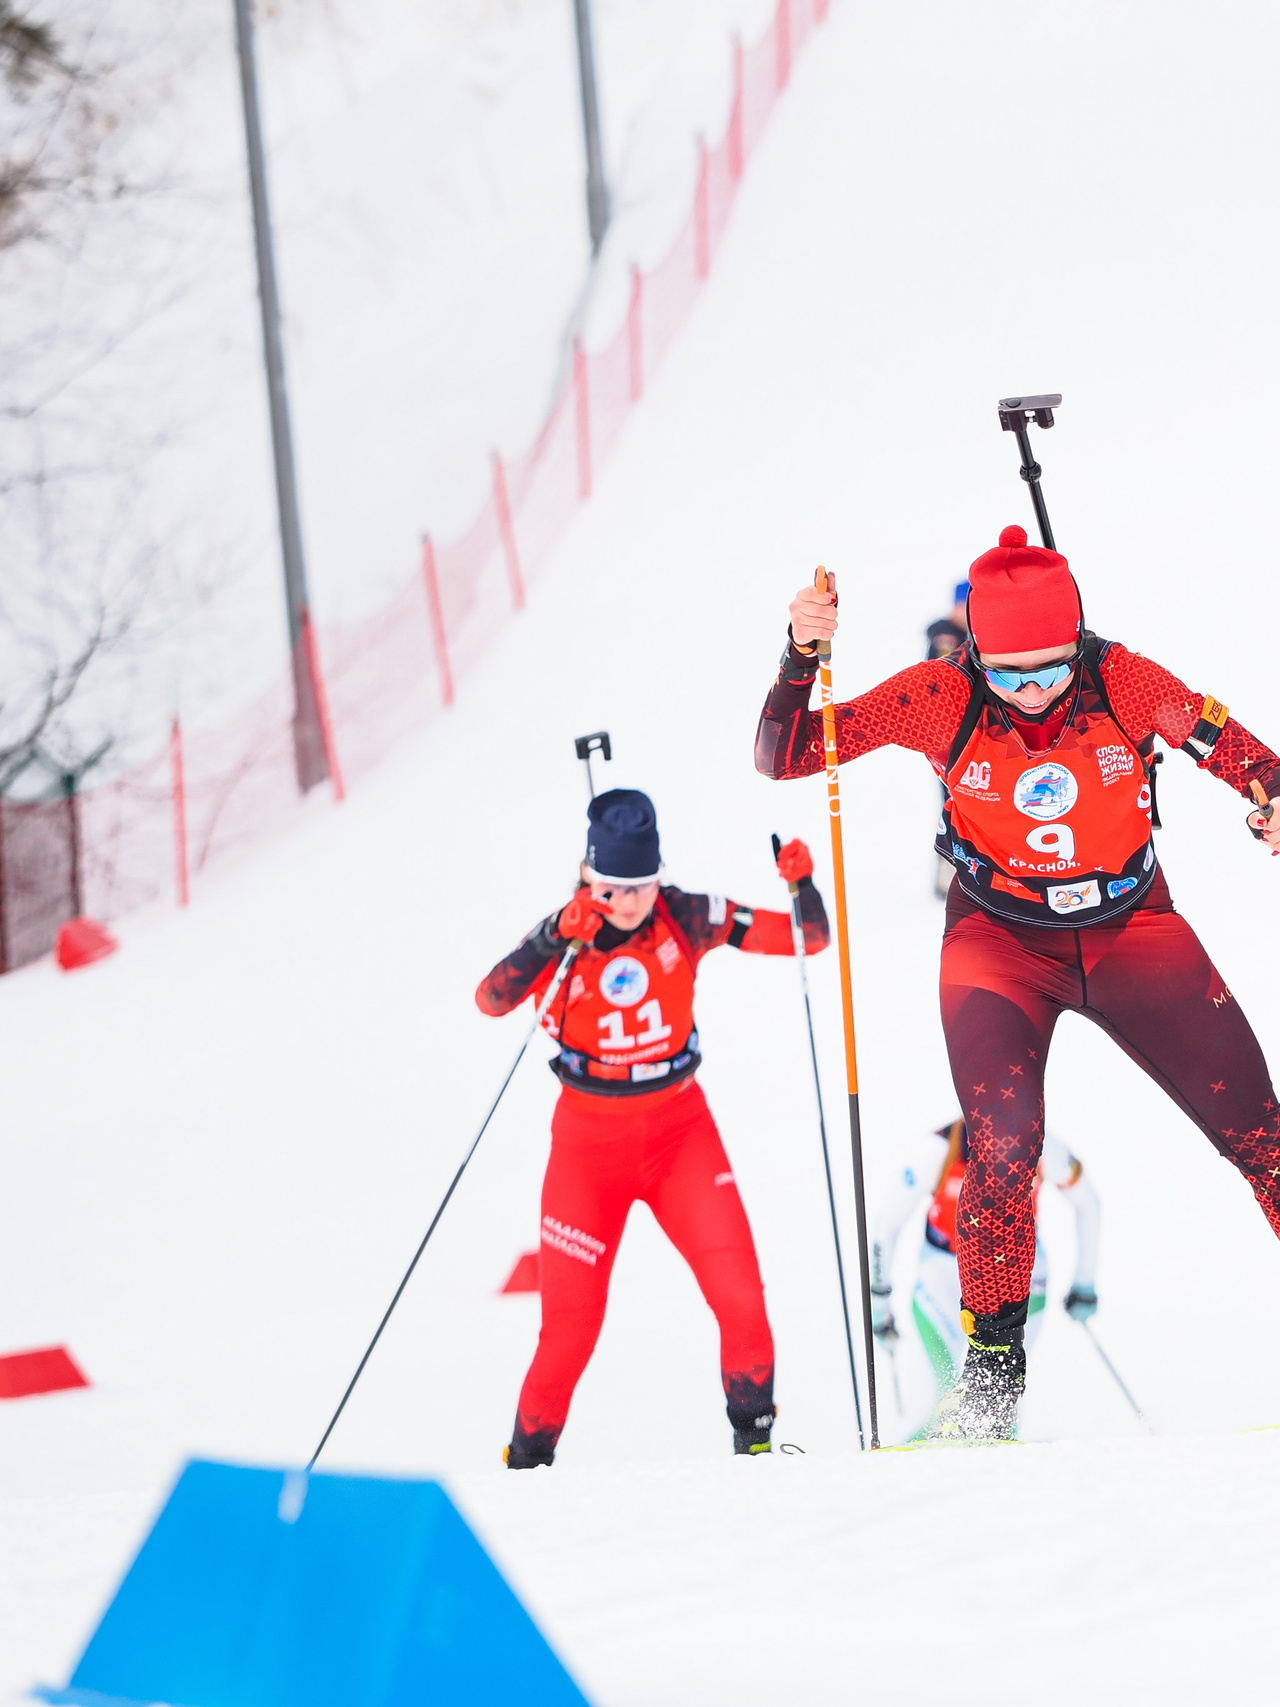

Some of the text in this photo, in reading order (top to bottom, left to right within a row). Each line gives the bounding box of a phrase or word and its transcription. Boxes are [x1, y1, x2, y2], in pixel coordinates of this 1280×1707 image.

[1098, 753, 1134, 767] НОРМА
[1025, 823, 1076, 861] 9
[597, 998, 673, 1049] 11
